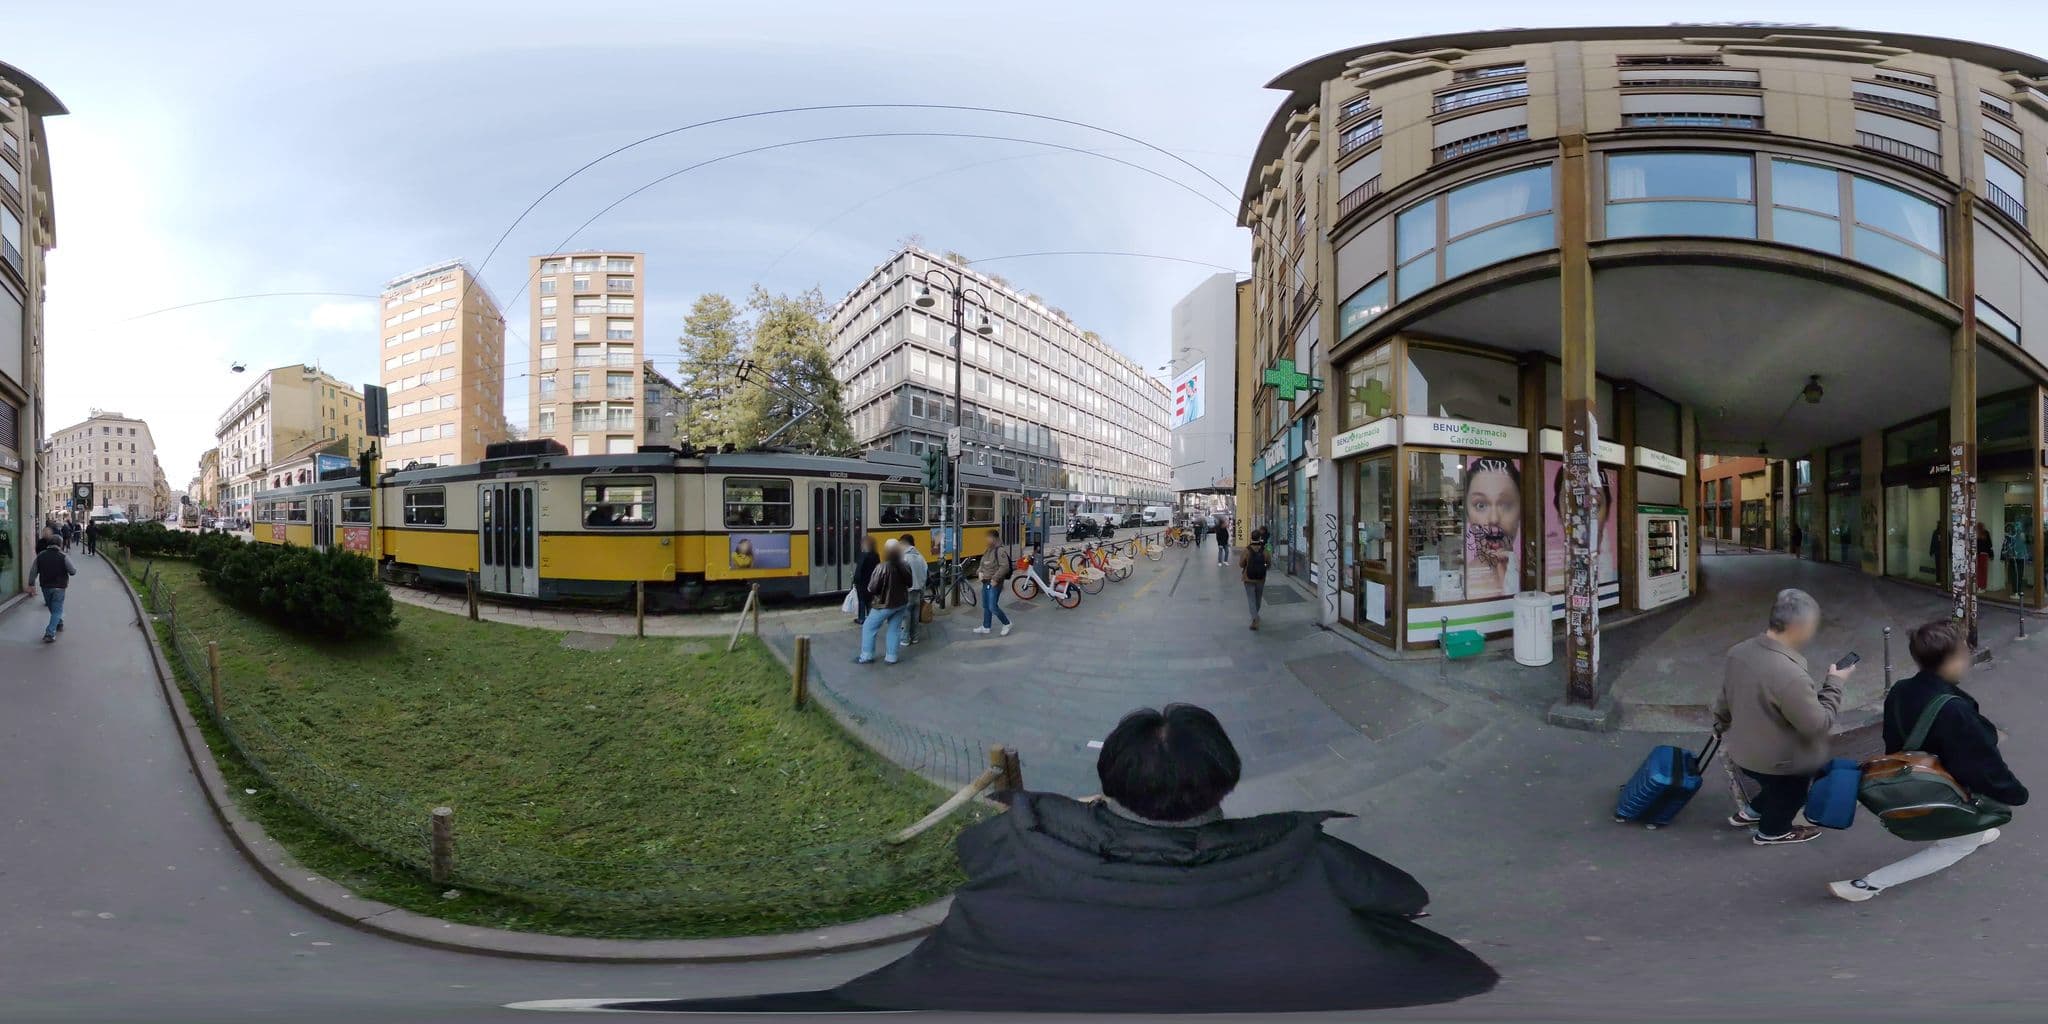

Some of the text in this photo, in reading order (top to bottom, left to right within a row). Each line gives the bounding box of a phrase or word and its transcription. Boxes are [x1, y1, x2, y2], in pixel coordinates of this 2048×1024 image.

[1433, 423, 1507, 438] BENU Farmacia
[1450, 435, 1493, 447] Carrobbio
[1480, 459, 1508, 476] SVR
